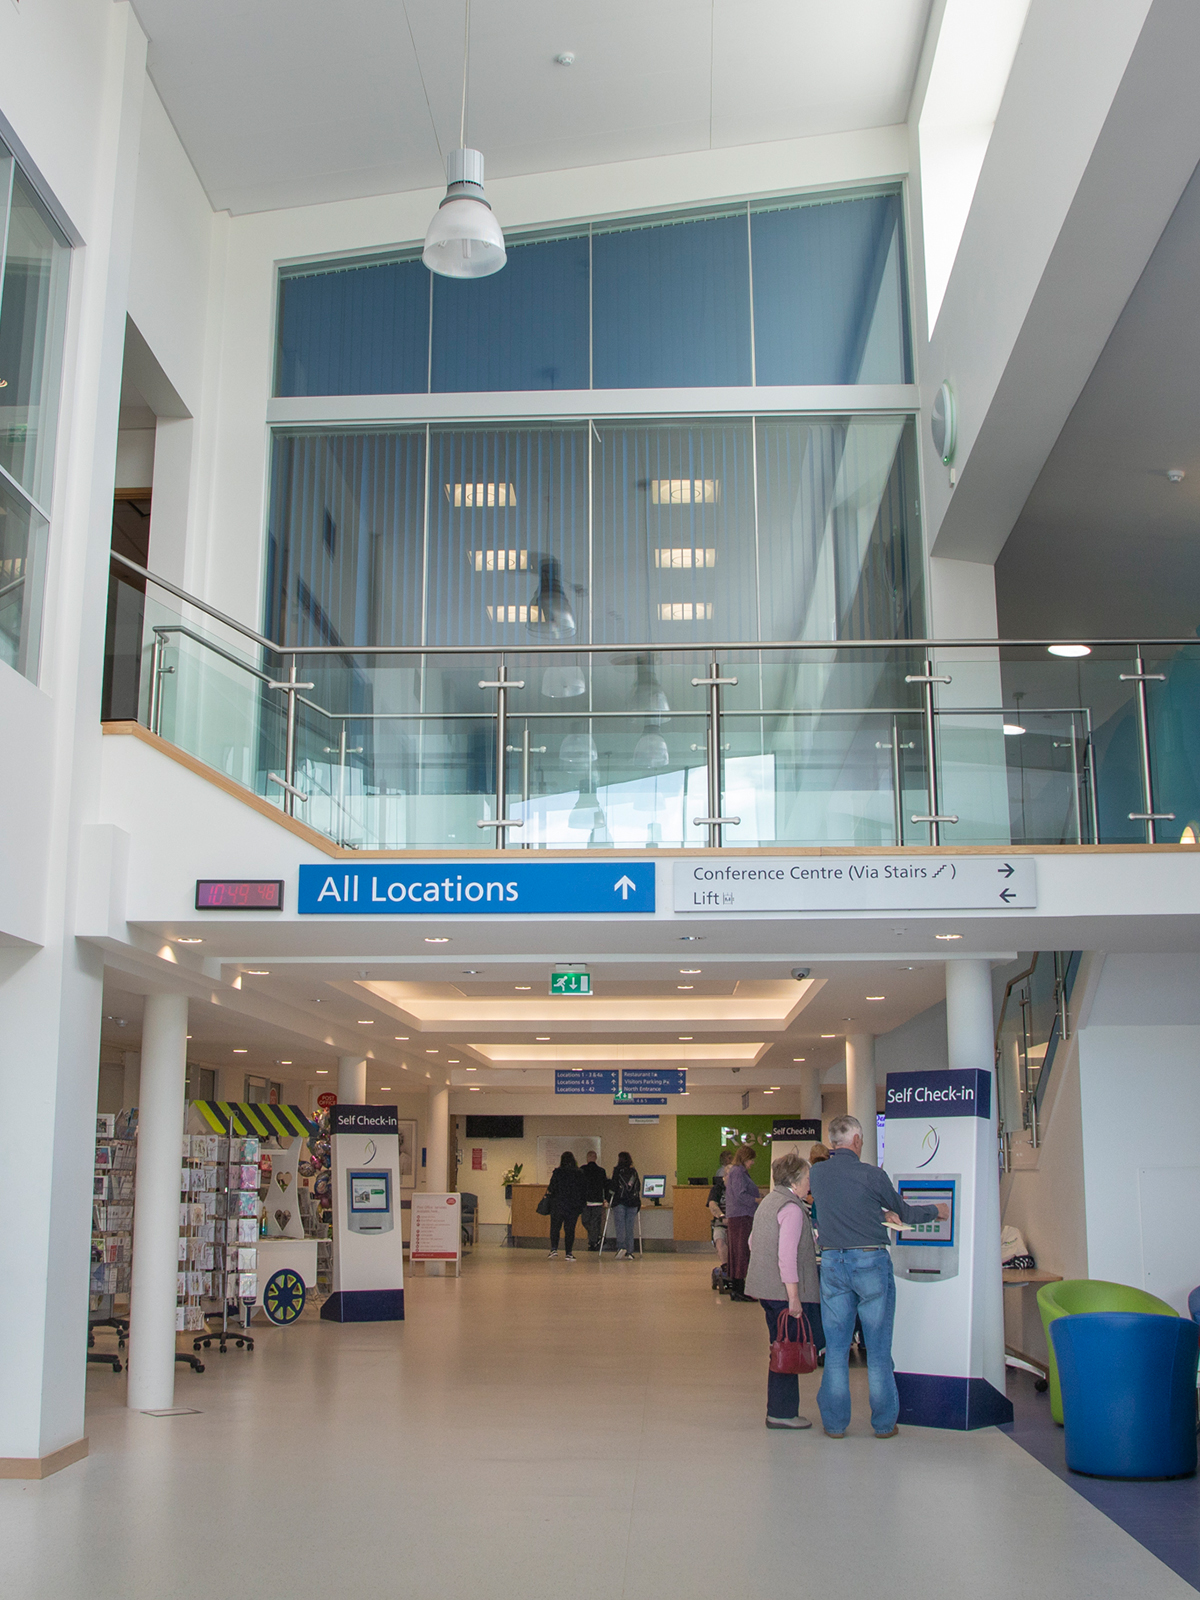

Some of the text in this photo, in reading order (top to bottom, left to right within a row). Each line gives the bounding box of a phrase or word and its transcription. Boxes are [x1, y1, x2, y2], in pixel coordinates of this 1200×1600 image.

[693, 866, 785, 881] Conference
[789, 866, 843, 880] Centre
[848, 864, 879, 881] (Via
[884, 864, 927, 878] Stairs
[316, 875, 519, 902] All Locations
[693, 891, 720, 905] Lift
[887, 1086, 975, 1104] Self Check-in
[338, 1116, 398, 1126] Self Check-in
[773, 1126, 815, 1135] Self Check-in
